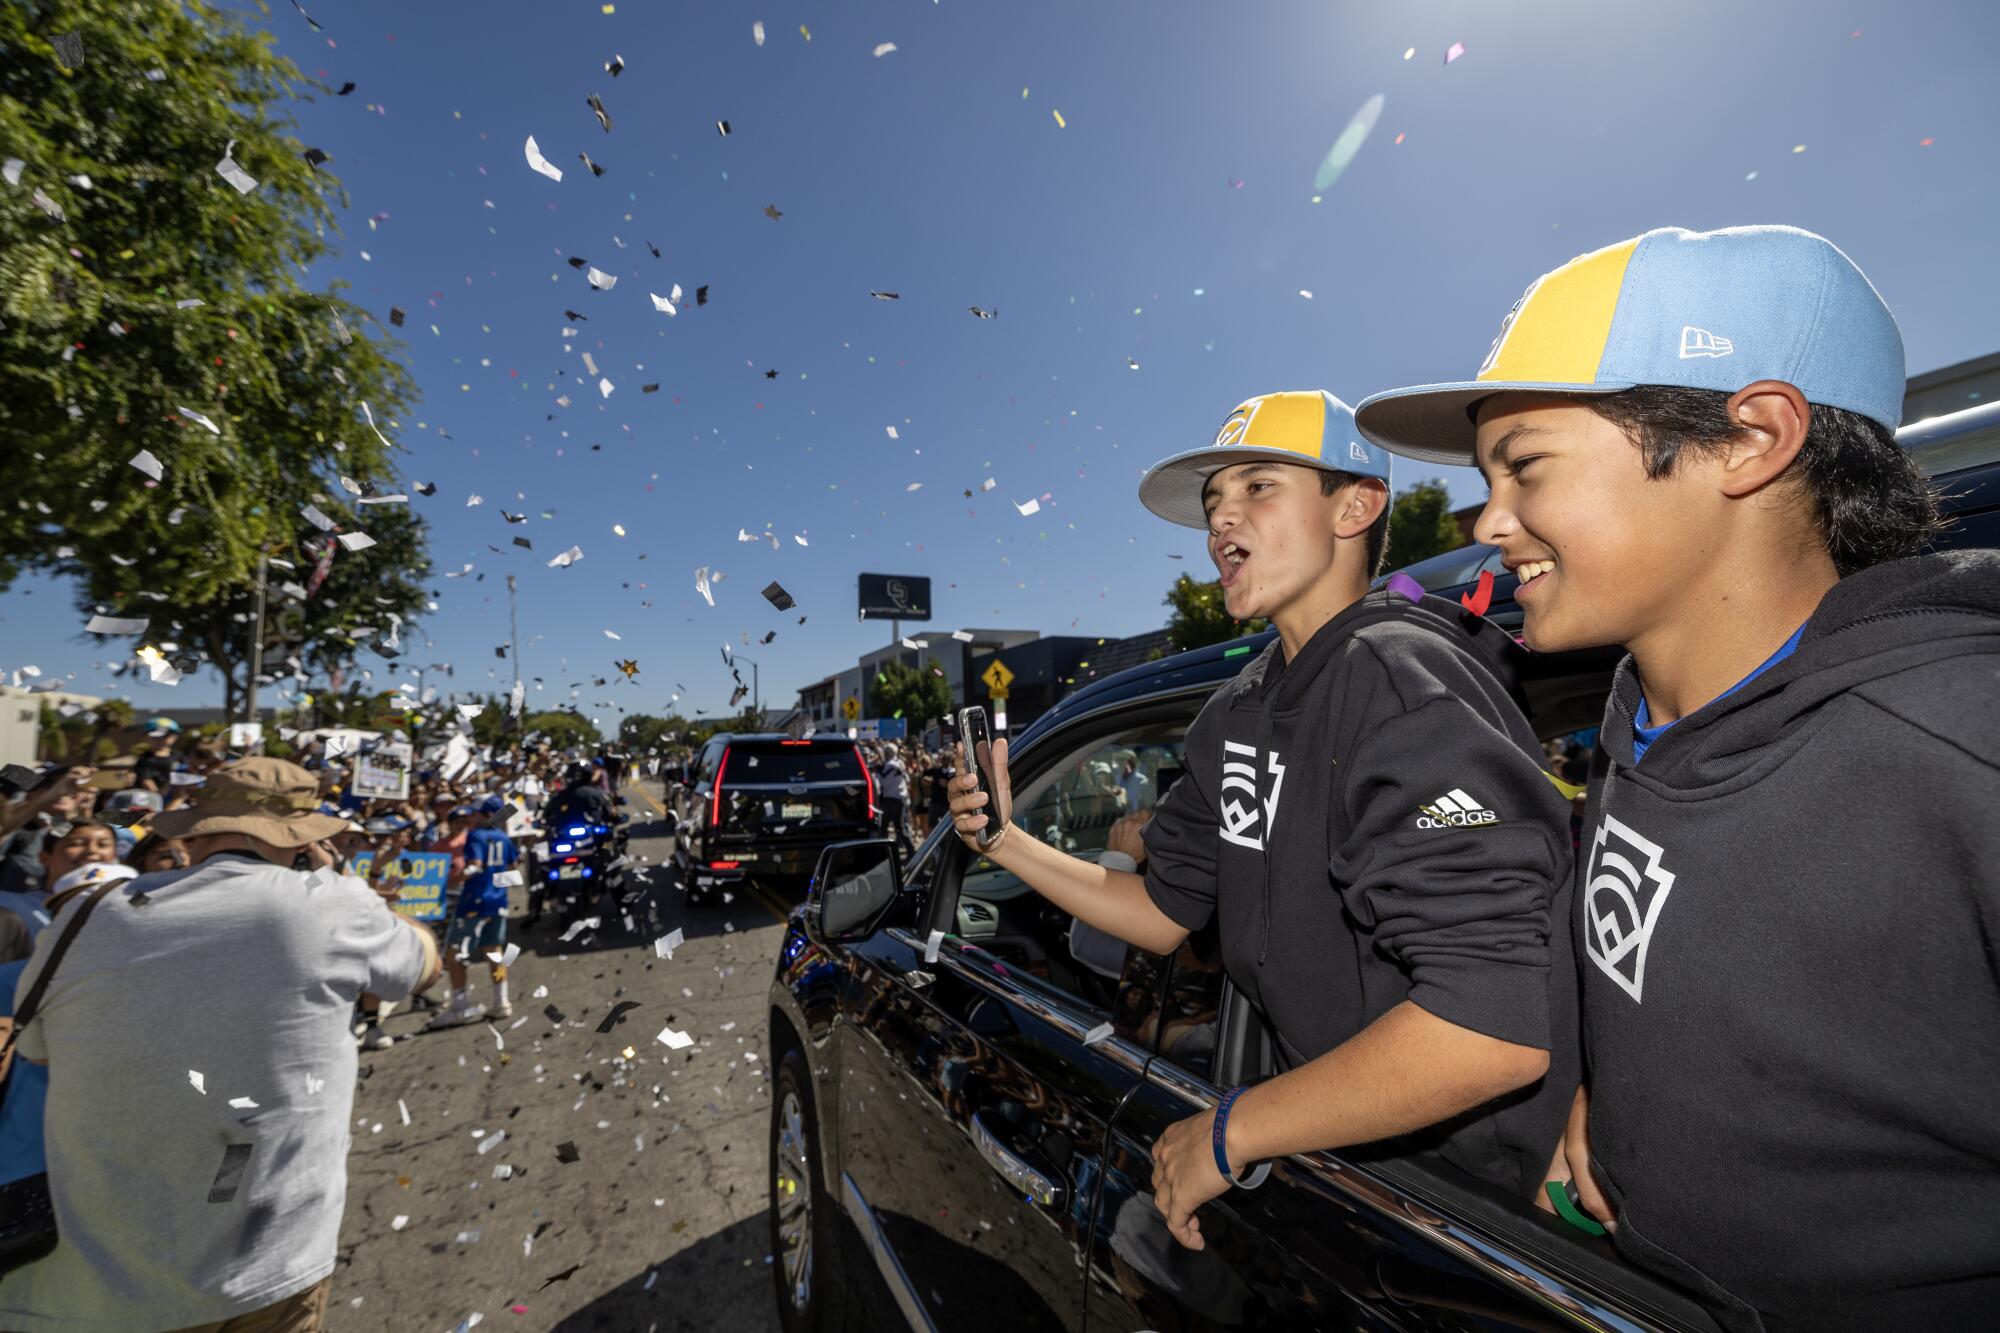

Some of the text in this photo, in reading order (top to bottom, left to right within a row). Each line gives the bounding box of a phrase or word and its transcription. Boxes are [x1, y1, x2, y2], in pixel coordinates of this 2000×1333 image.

[1416, 809, 1496, 829] adidas
[488, 841, 504, 867] 11
[356, 859, 426, 879] GNO
